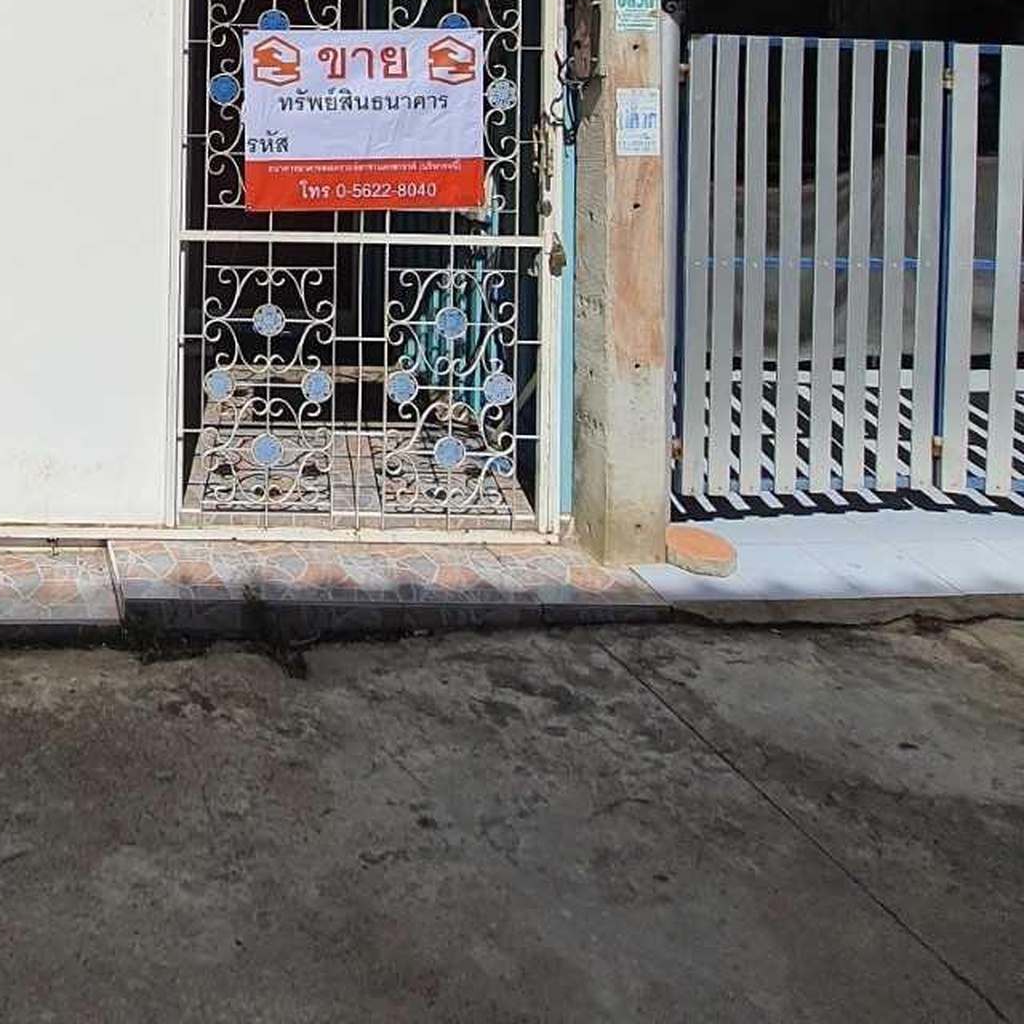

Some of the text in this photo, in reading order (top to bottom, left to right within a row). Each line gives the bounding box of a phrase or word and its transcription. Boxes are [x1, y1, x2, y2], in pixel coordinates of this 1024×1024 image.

[318, 46, 408, 79] ขาย
[279, 87, 449, 111] ทรัพย์สินธนาคาร
[247, 130, 289, 153] รหัส
[299, 180, 437, 199] โทร 0-5622-8040
